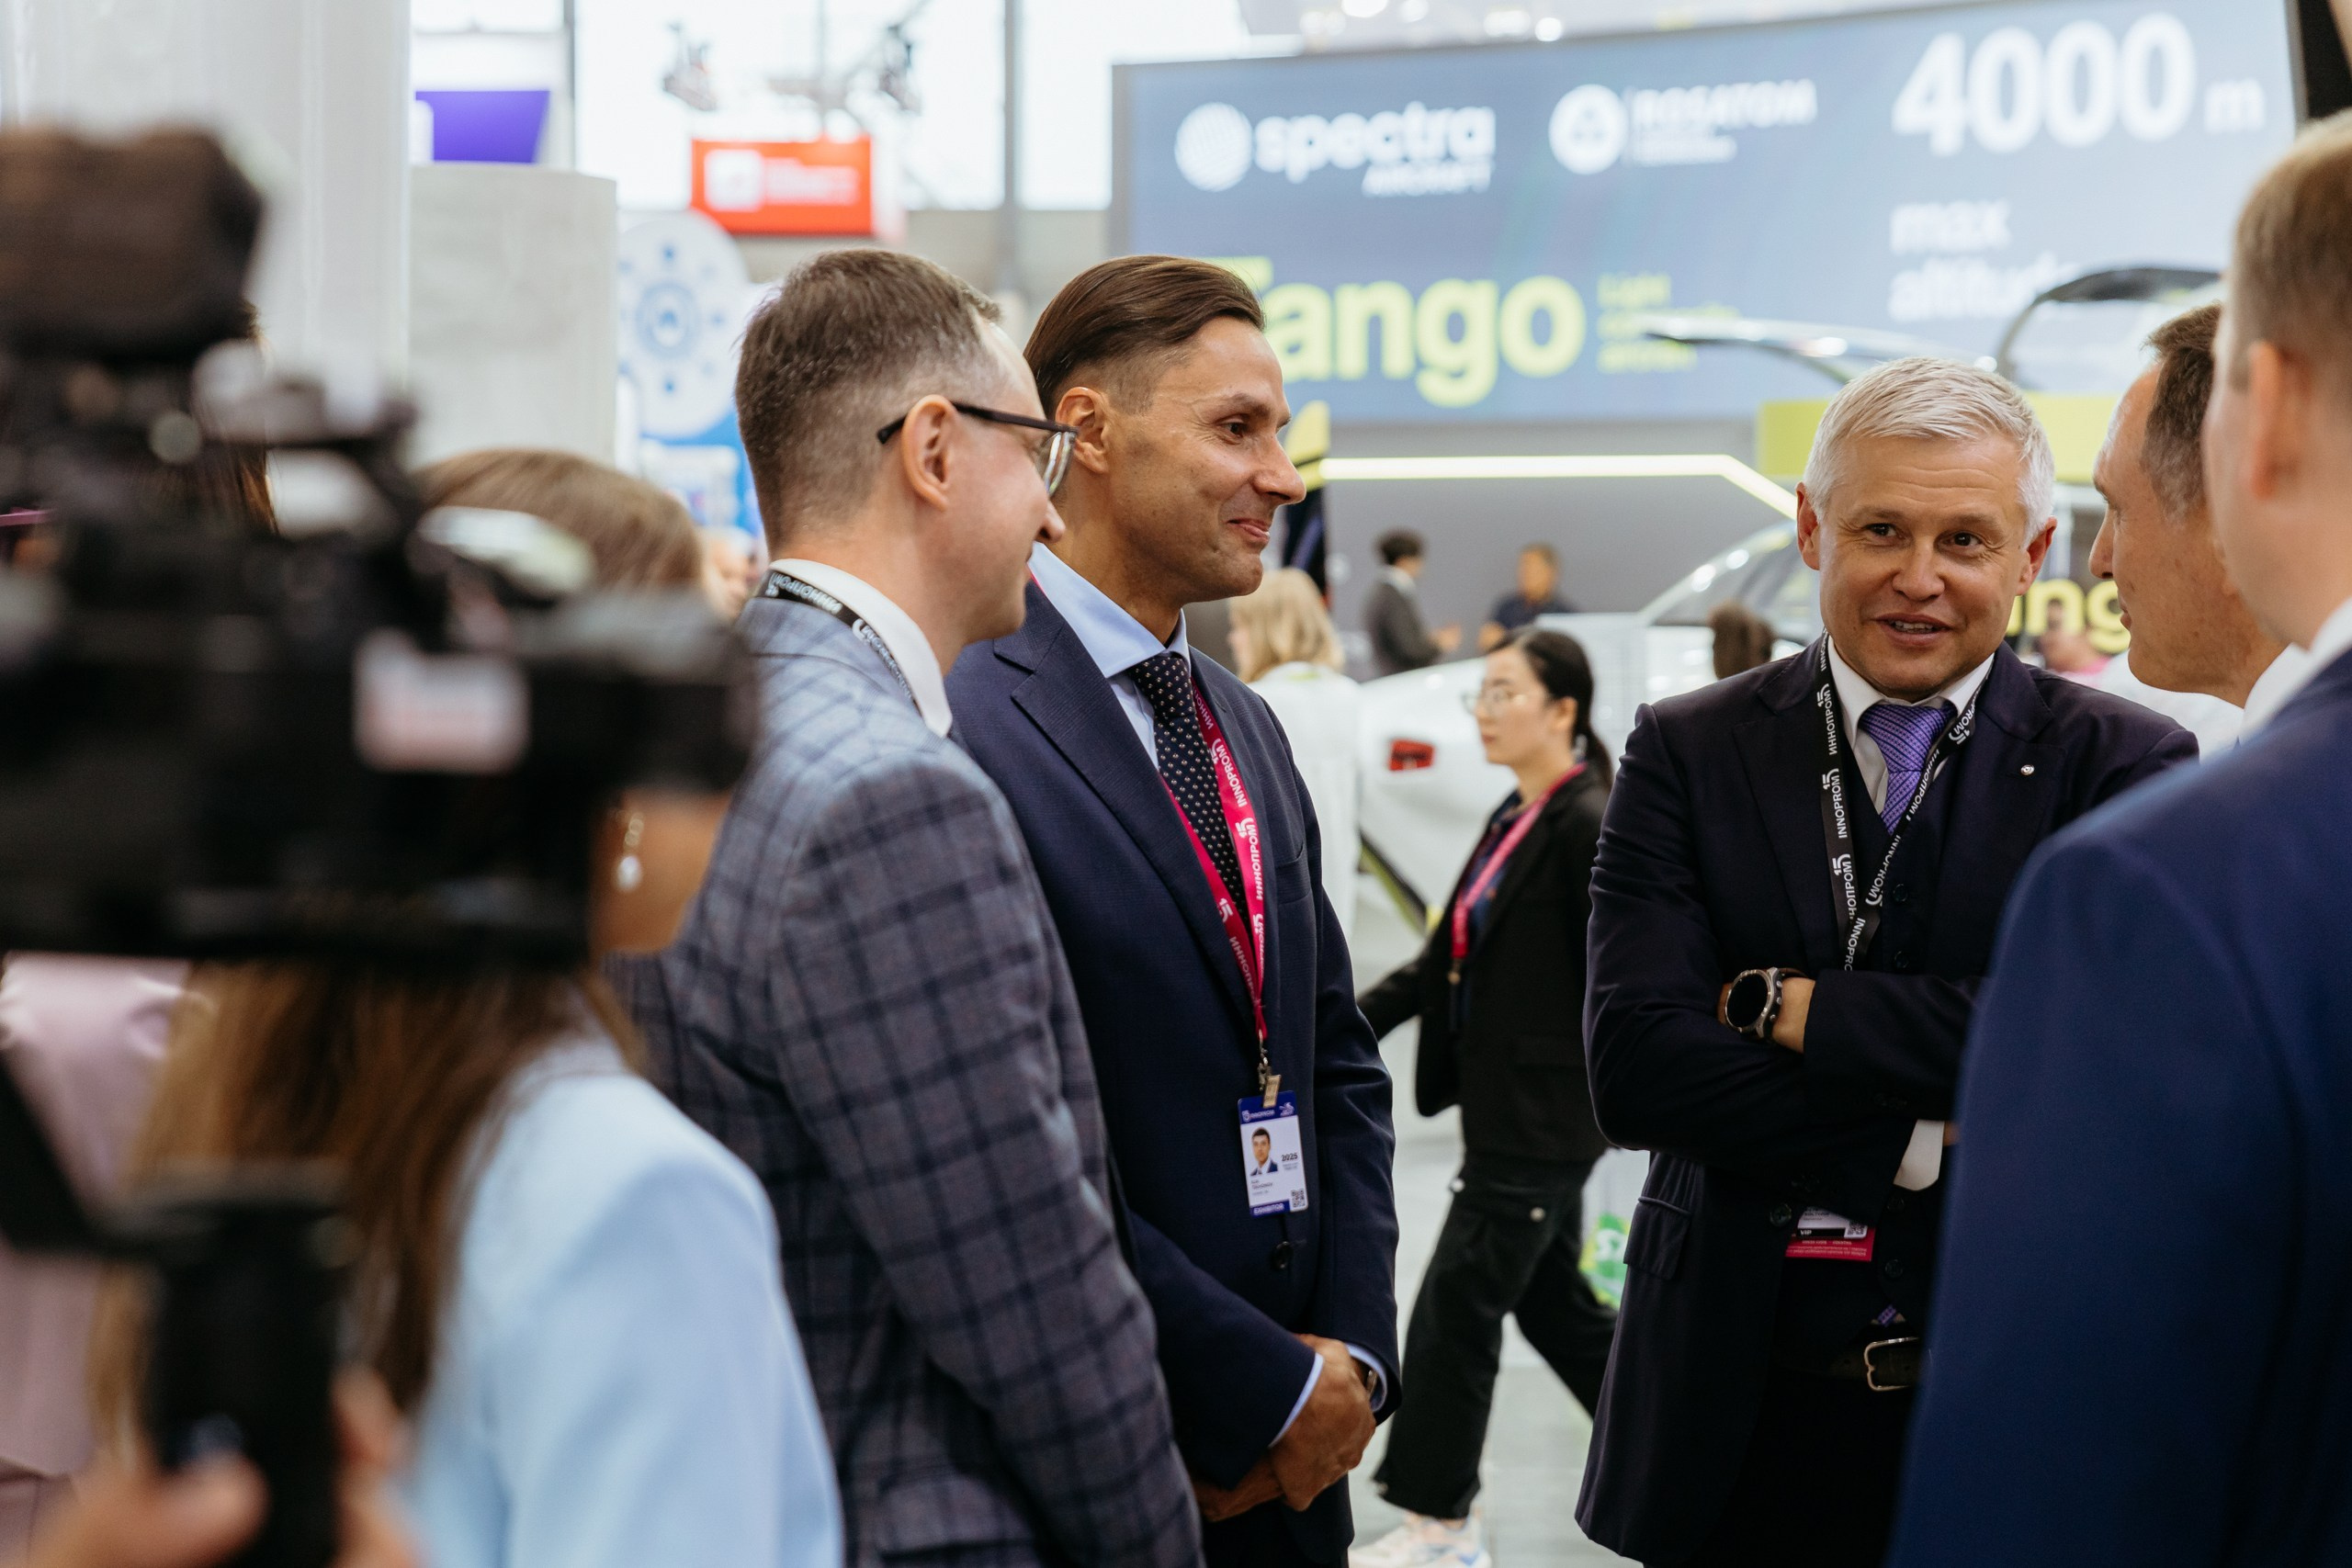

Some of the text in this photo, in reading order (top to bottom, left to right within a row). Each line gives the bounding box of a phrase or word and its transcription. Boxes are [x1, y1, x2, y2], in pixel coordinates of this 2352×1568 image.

[1891, 12, 2267, 157] 4000 m
[1255, 100, 1496, 184] spectra
[1890, 199, 2012, 256] max
[1888, 254, 2078, 322] altitud
[1816, 683, 1829, 707] 15
[1824, 690, 1838, 756] ИННОПРОМ
[1948, 728, 1971, 745] 15
[1216, 744, 1248, 807] INNOPROM
[1822, 768, 1839, 790] 15
[1830, 775, 1848, 839] INNOPROM
[1909, 750, 1940, 816] ИННОПРОМ
[1235, 817, 1254, 839] 15
[1246, 824, 1264, 901] ИННОПРОМ
[1832, 853, 1850, 876] 15
[1282, 1152, 1298, 1162] 2025
